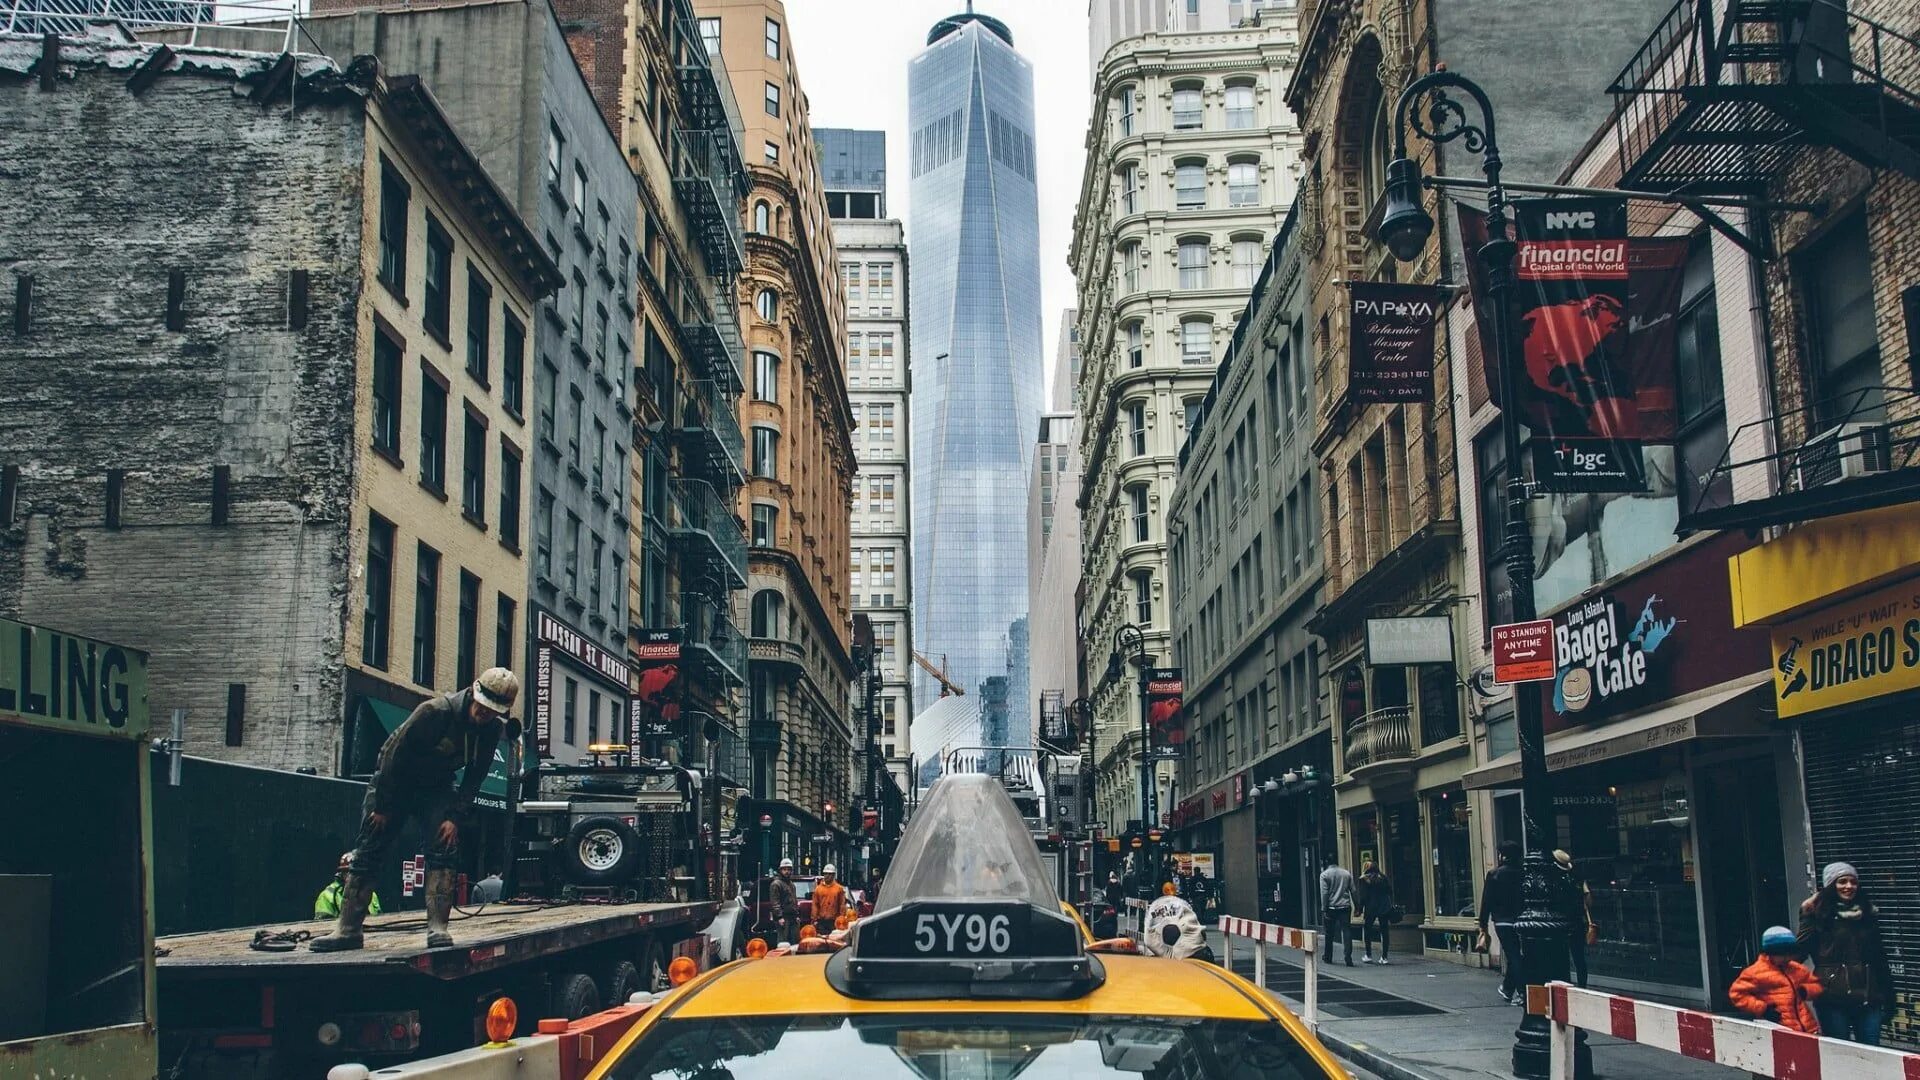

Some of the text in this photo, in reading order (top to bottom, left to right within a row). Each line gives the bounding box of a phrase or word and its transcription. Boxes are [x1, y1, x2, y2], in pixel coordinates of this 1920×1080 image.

[1546, 211, 1595, 230] NYC
[1519, 244, 1624, 268] financial
[1529, 263, 1625, 273] Capital of the World
[1369, 336, 1414, 350] Massage
[1374, 350, 1408, 361] Center
[1573, 448, 1606, 471] bgc
[1567, 596, 1606, 626] Long Island
[1812, 620, 1845, 640] WHILE
[1869, 602, 1899, 624] WAIT
[1497, 626, 1547, 640] NO STANDING
[1504, 638, 1542, 650] ANYTIME
[1555, 603, 1618, 668] Bagel
[546, 618, 581, 657] NASSAU
[601, 653, 628, 686] DENTAL
[640, 644, 679, 656] financial
[1811, 626, 1896, 692] DRAGO
[538, 647, 550, 689] NASSAU
[1596, 641, 1646, 697] Cafe
[1149, 681, 1182, 691] financial
[537, 704, 549, 740] DENTAL
[914, 913, 1011, 953] 5Y96
